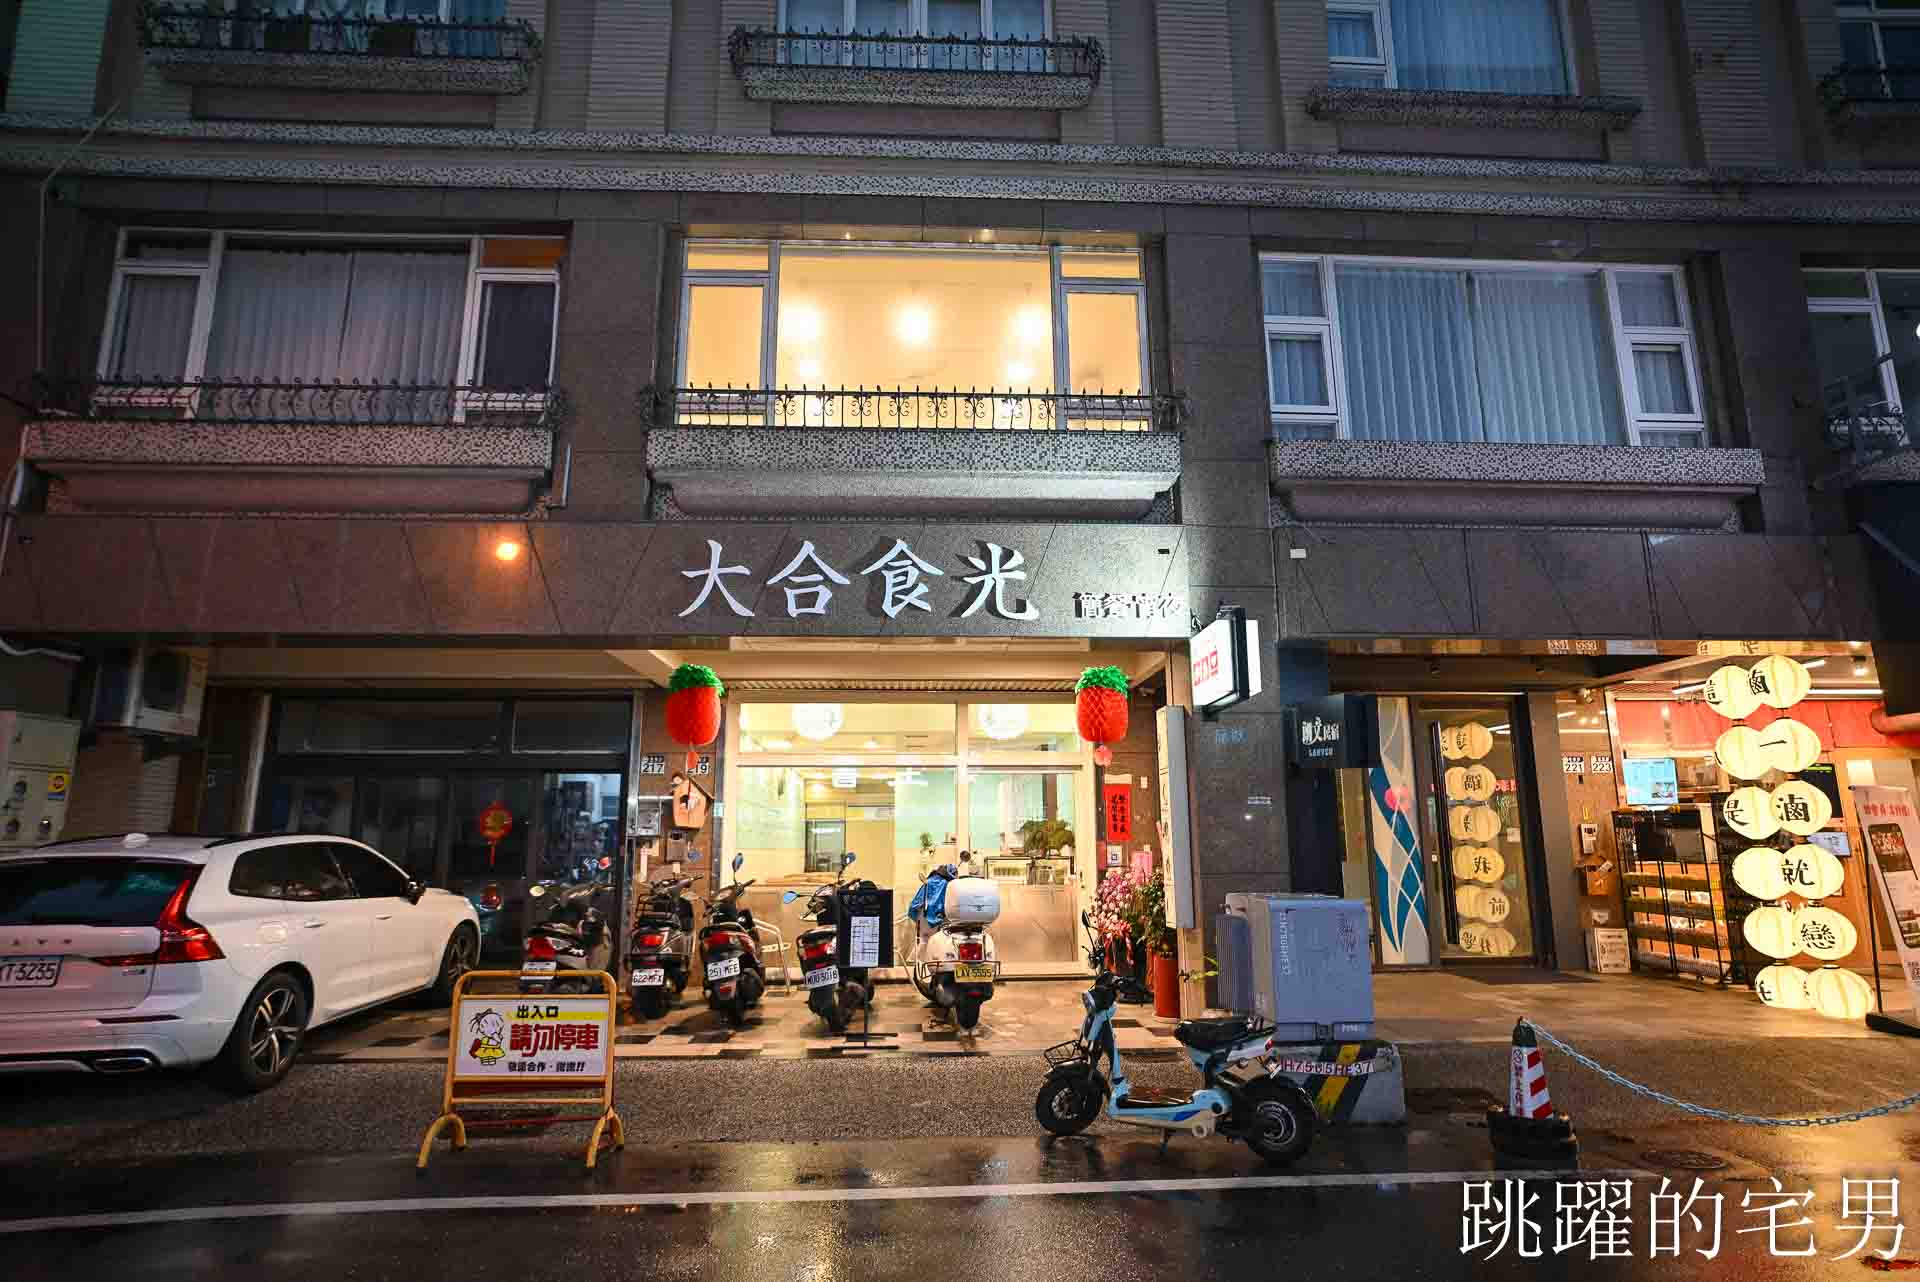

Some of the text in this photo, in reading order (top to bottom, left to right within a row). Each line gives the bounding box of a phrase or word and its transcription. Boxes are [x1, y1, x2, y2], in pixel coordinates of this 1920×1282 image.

[679, 538, 1040, 620] 大合食光
[642, 763, 664, 773] 217
[1565, 763, 1583, 772] 221
[1592, 763, 1611, 772] 223
[516, 1004, 560, 1019] 出入口
[509, 1023, 600, 1057] 請勿停車
